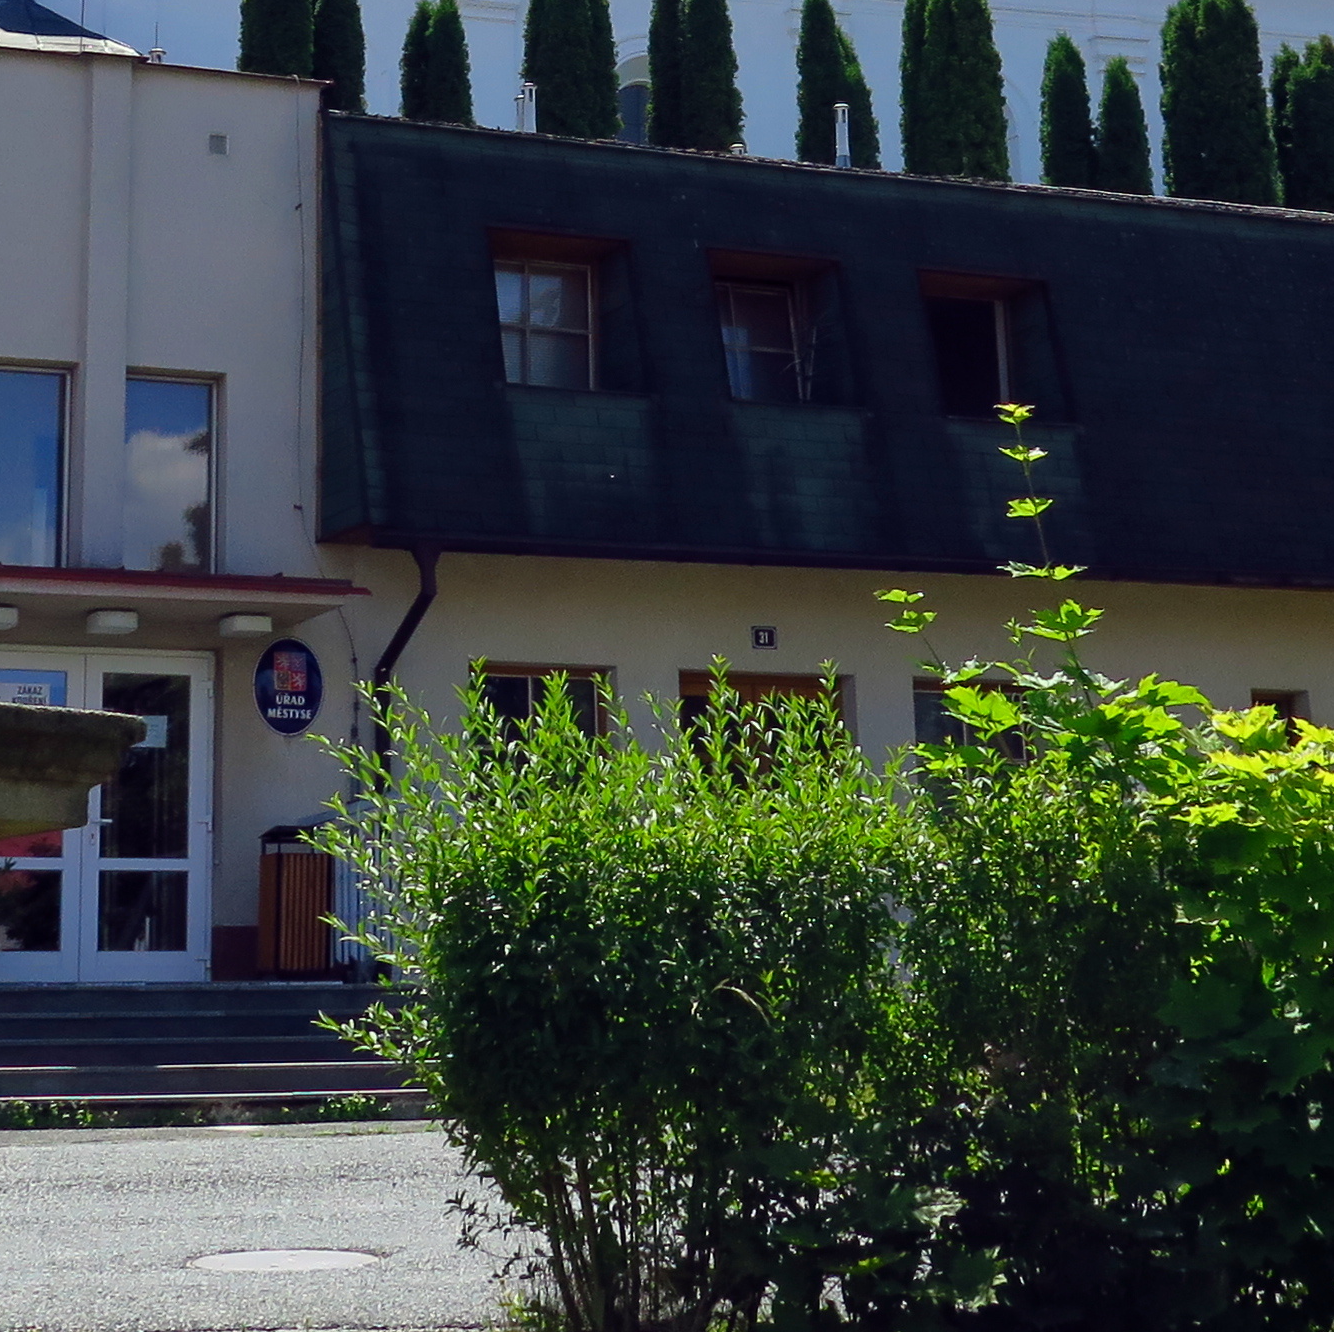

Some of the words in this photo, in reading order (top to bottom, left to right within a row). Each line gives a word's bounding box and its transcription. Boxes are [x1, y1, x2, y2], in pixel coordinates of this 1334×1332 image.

[759, 631, 768, 644] 31
[17, 685, 43, 695] ZÁKAZ
[276, 692, 305, 705] ÚŘAD
[267, 706, 312, 719] MĚSTYSE
